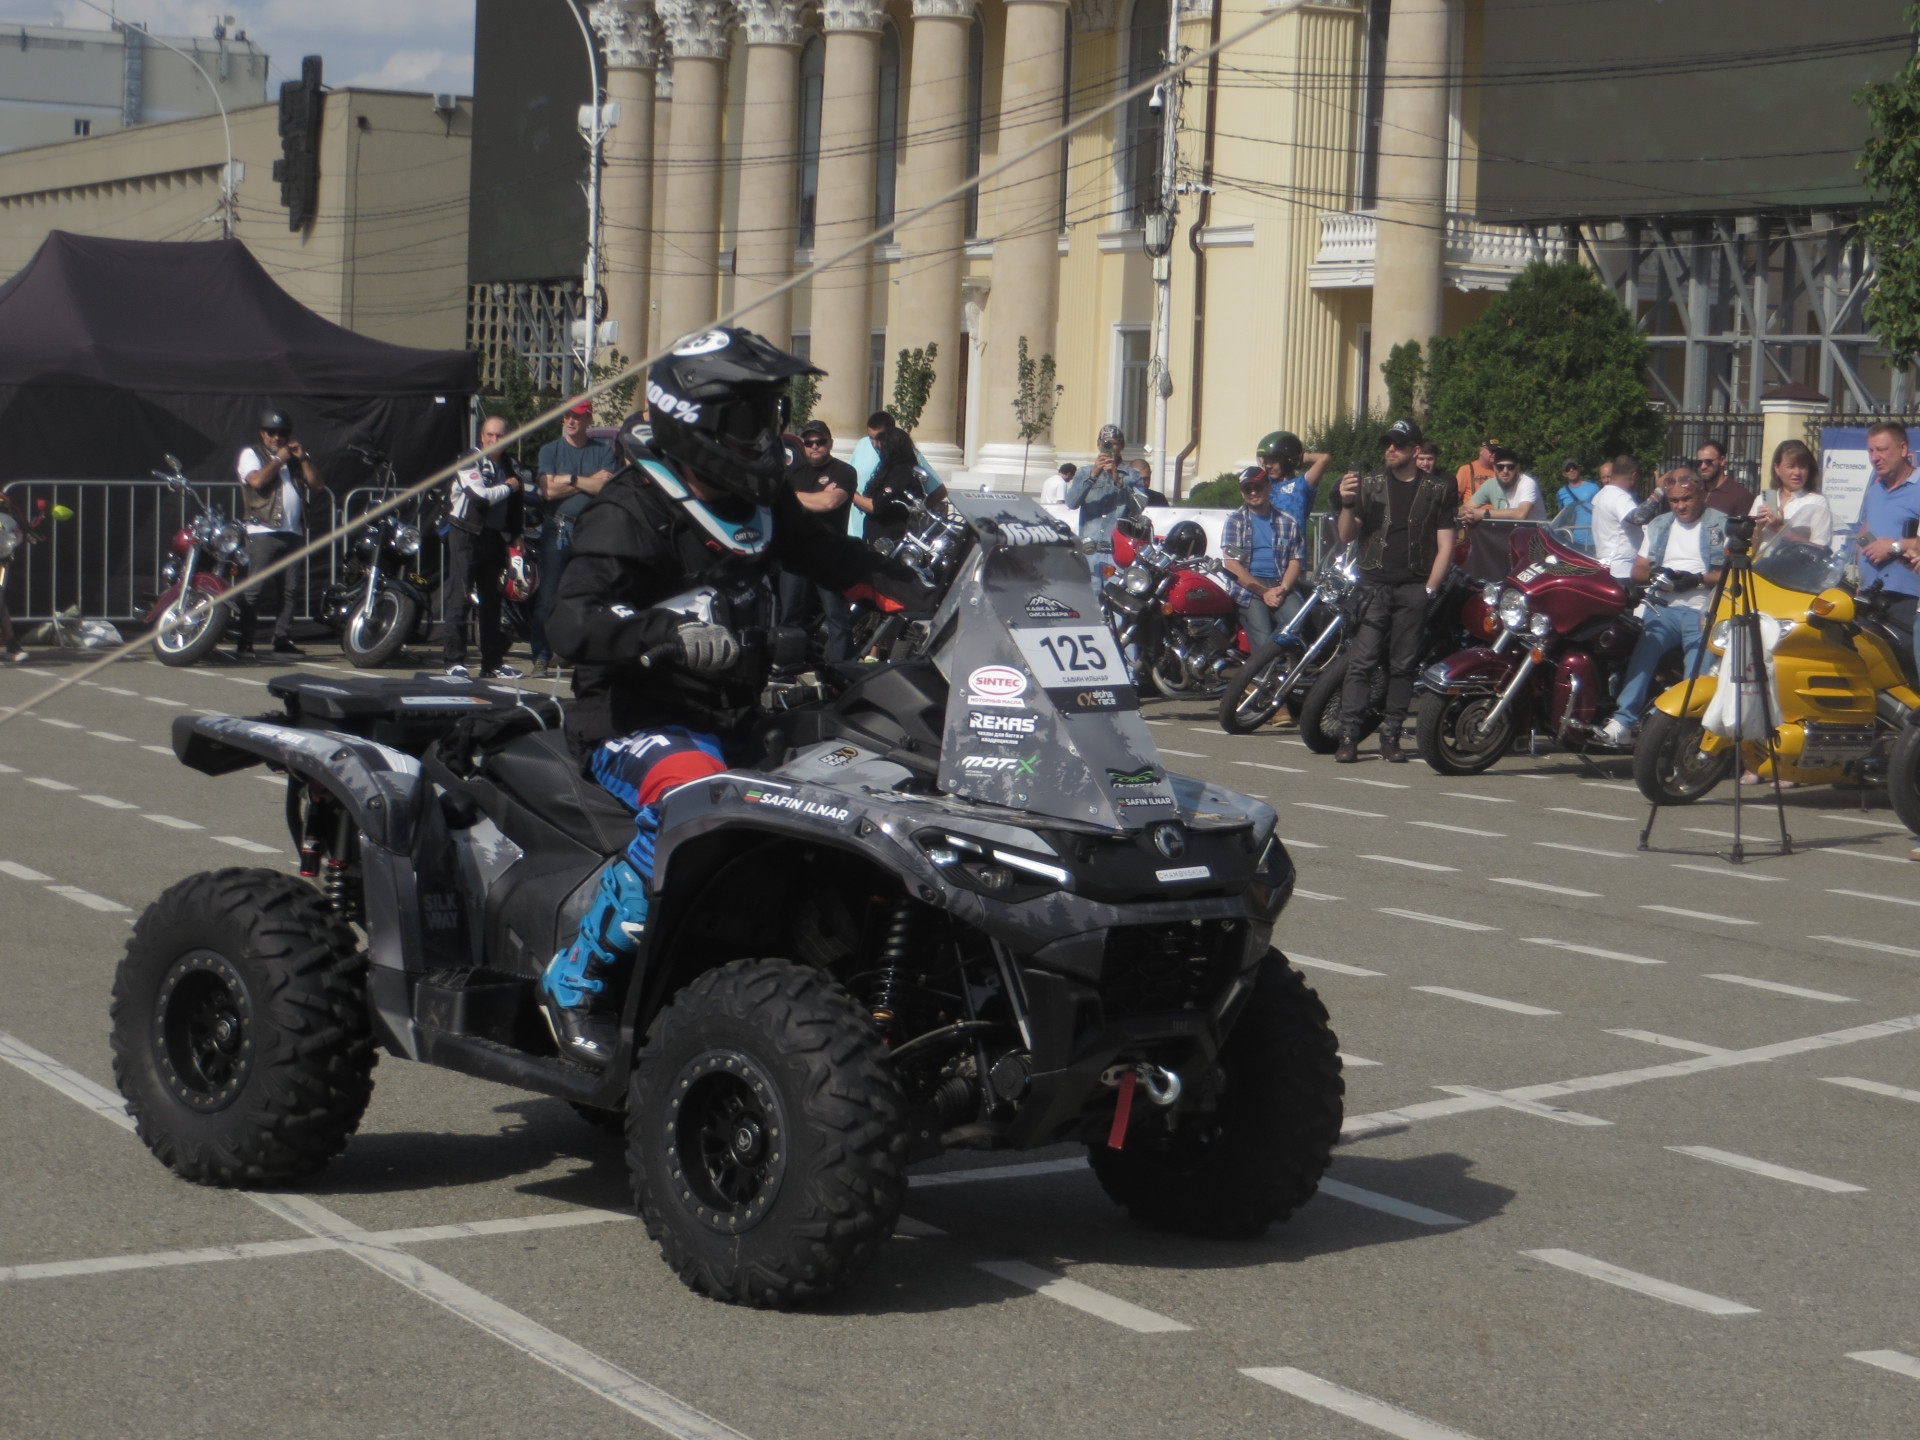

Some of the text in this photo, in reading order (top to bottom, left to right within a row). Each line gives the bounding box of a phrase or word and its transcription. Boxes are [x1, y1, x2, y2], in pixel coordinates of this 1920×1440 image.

[1831, 461, 1867, 470] Ростелеком
[1039, 634, 1107, 671] 125
[975, 677, 1020, 687] SINTEC
[1092, 689, 1114, 700] alpha
[1097, 697, 1116, 705] race
[759, 793, 849, 820] SAFIN ILNAR
[1125, 797, 1171, 806] SAFIN ILNAR
[423, 893, 457, 911] SILK
[424, 911, 458, 930] WAY
[571, 1036, 600, 1049] 3.5
